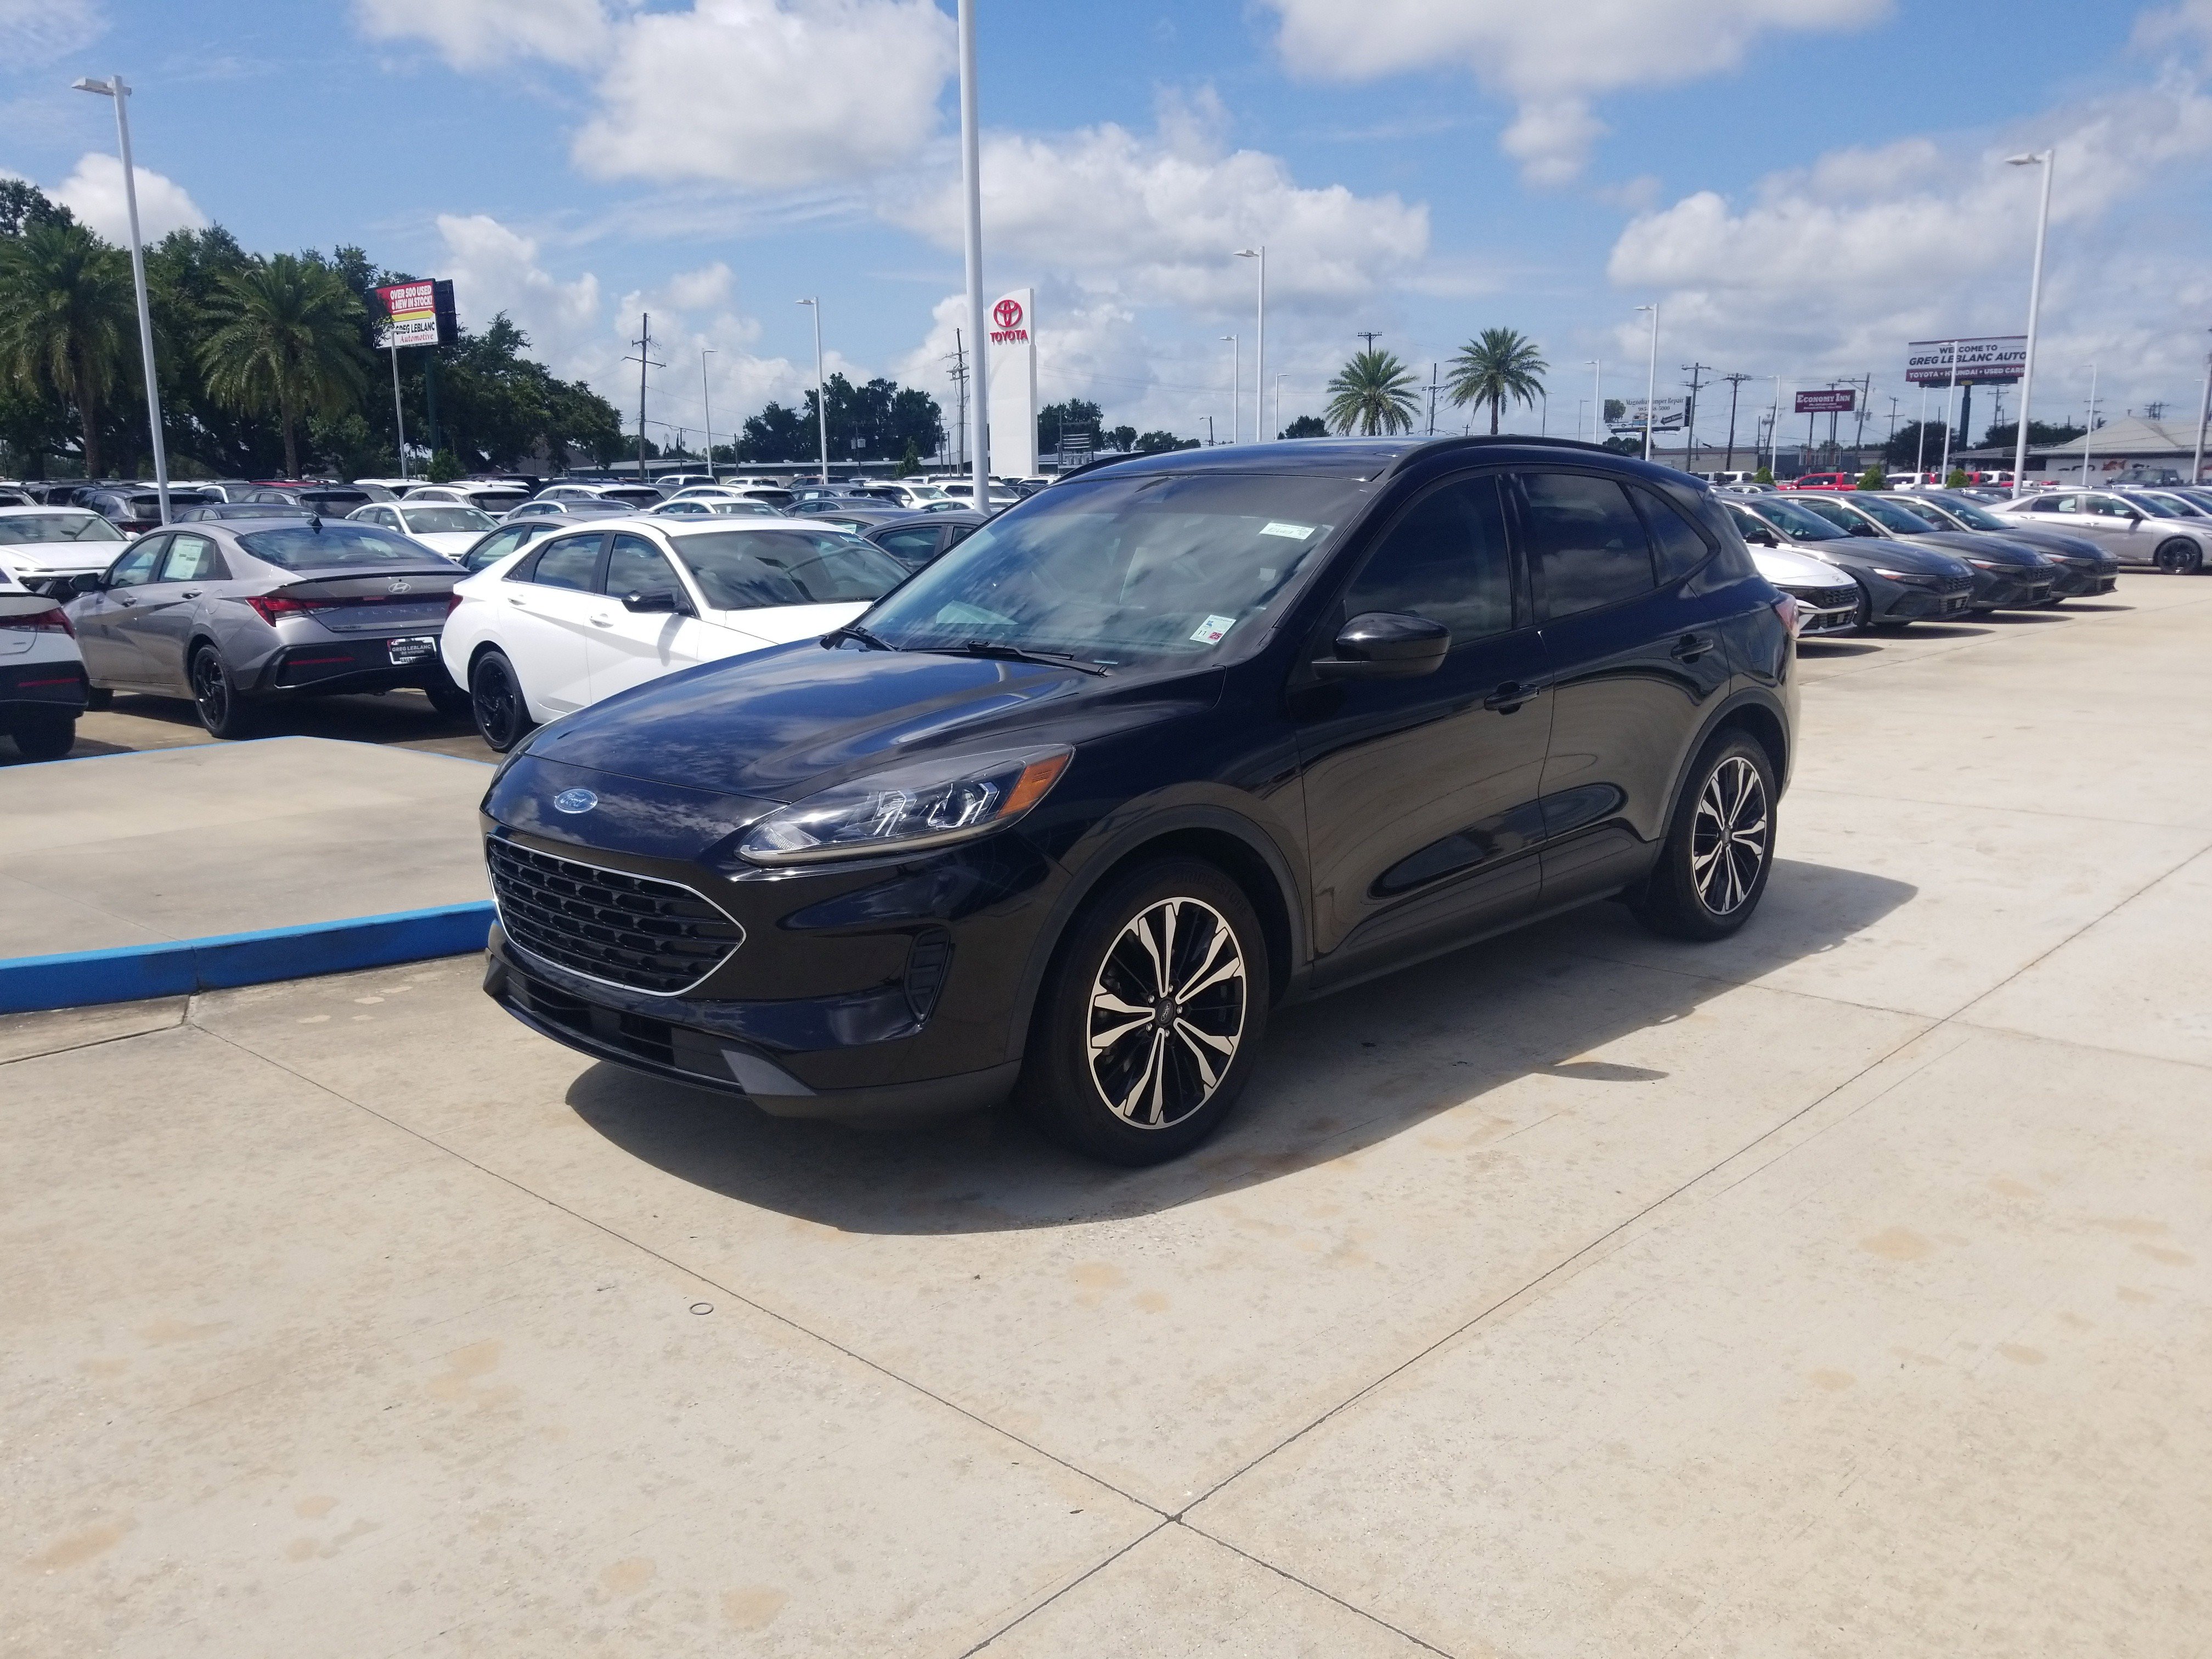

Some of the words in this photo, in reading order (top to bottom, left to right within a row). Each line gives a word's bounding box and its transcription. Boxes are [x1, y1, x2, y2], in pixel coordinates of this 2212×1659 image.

[390, 289, 405, 300] OVER
[405, 286, 416, 297] 500
[417, 285, 432, 296] USED
[391, 302, 395, 310] &
[396, 298, 408, 309] NEW
[408, 297, 414, 307] IN
[414, 295, 432, 307] STOCK!
[396, 324, 410, 335] GREG
[411, 321, 435, 333] LEBLANC
[400, 332, 434, 343] Automotive
[990, 329, 1029, 342] TOYOTA
[1939, 345, 1983, 354] WECOME
[1909, 356, 1939, 365] GREG
[1940, 353, 1993, 364] LEBLANC
[1995, 351, 2027, 361] AUTO
[1797, 394, 1835, 403] ECONOMY
[1836, 393, 1850, 401] INN
[358, 606, 445, 616] ELANTRA
[560, 792, 587, 808] Ford
